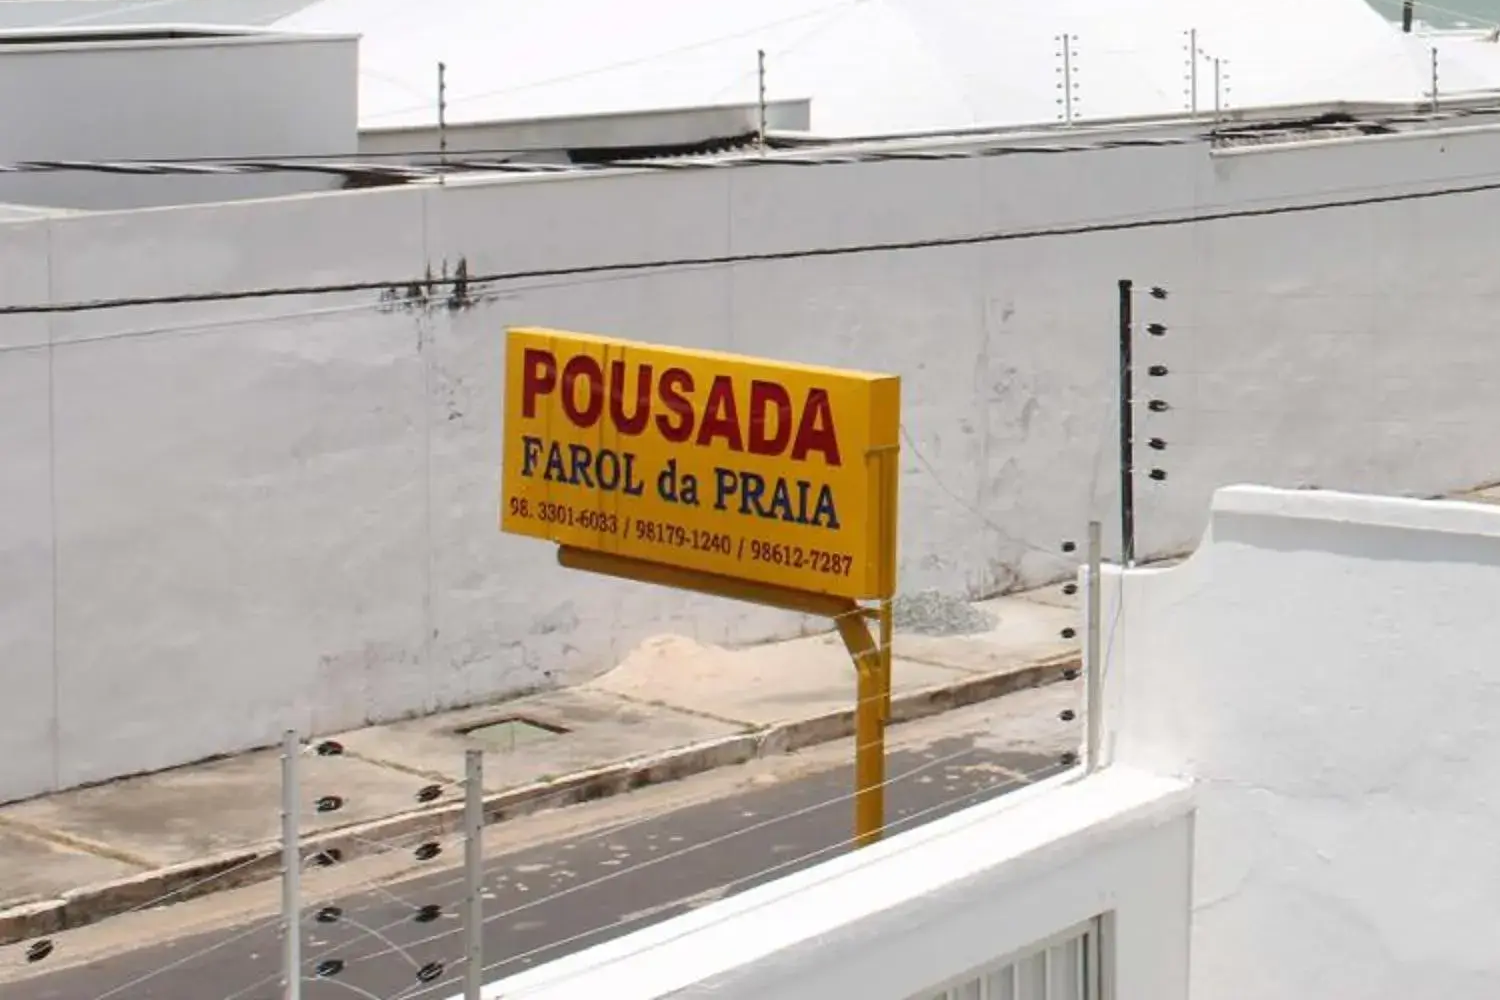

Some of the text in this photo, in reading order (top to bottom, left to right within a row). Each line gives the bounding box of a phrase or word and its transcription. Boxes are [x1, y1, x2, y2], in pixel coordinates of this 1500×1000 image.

[522, 347, 842, 467] POUSADA
[520, 435, 841, 530] FAROL da PRAIA
[510, 495, 533, 519] 98.
[635, 519, 732, 556] 98179-1240
[750, 539, 854, 577] 98612-7287
